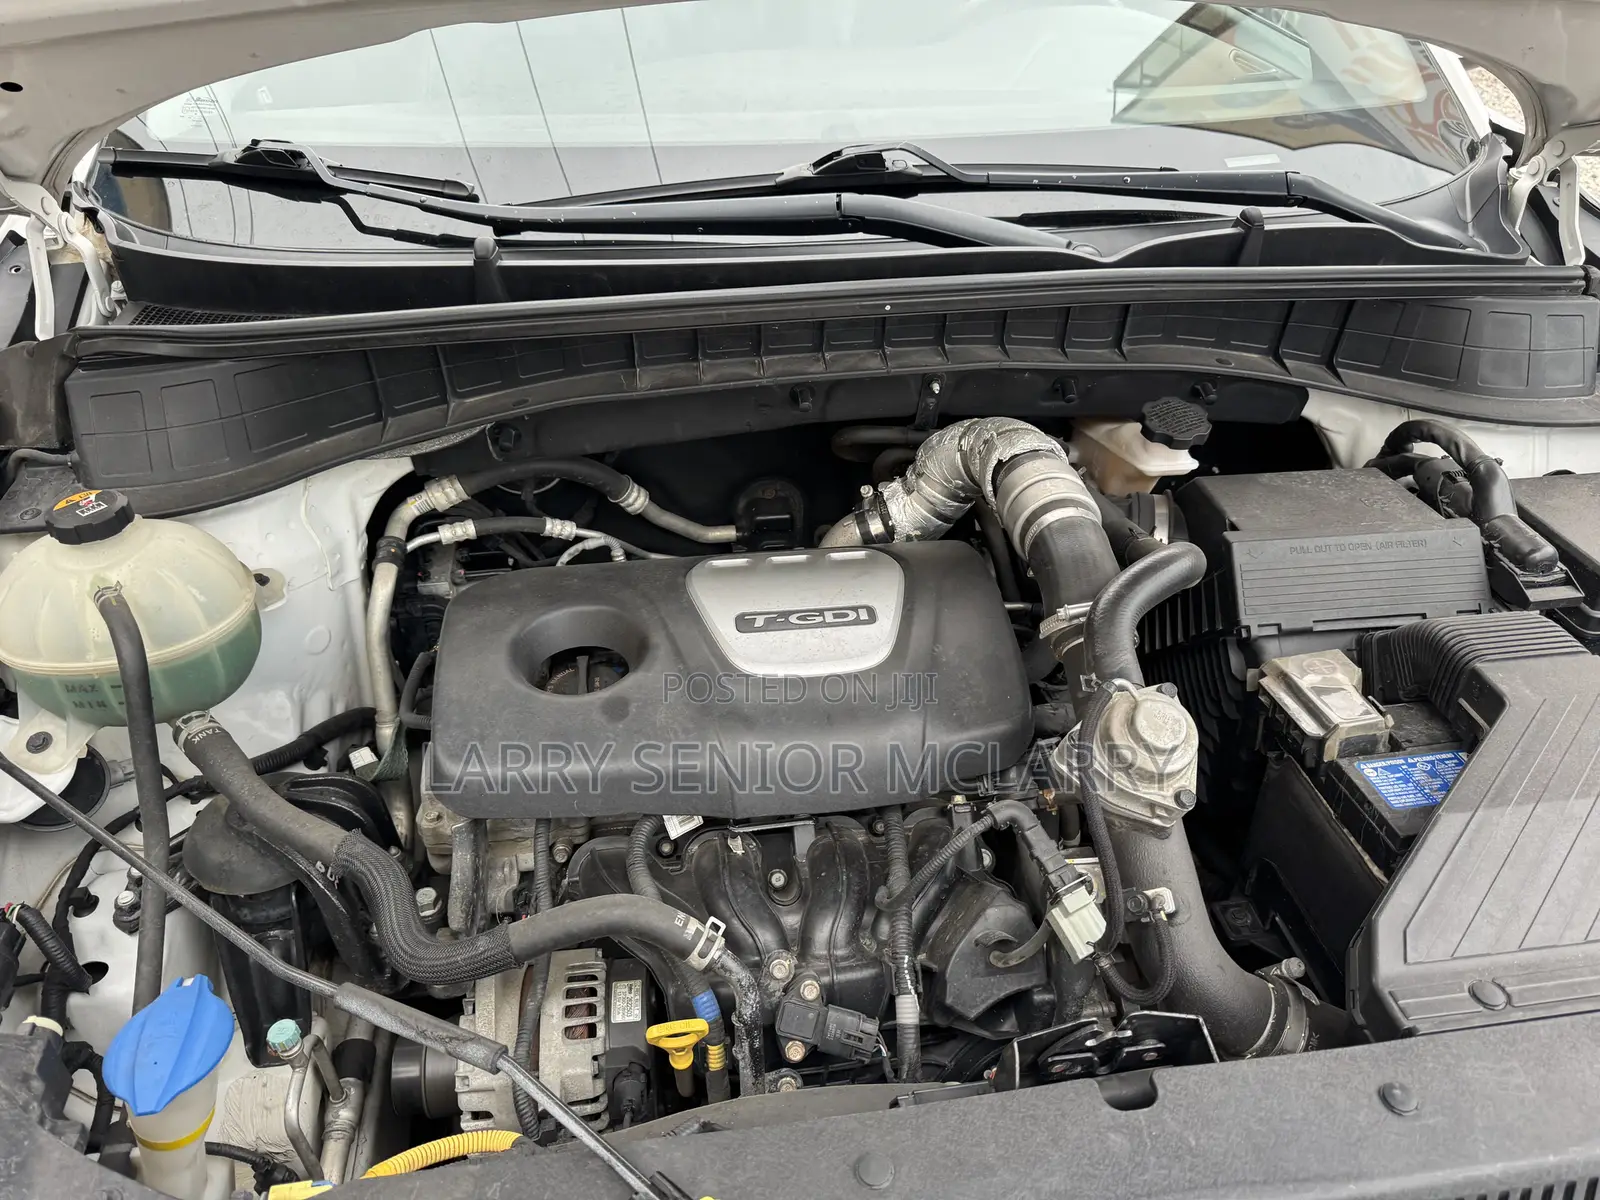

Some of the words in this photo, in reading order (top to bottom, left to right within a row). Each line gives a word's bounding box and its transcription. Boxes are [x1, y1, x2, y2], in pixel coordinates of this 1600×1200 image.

[1289, 545, 1312, 555] PULL
[1314, 545, 1332, 554] OUT
[1335, 544, 1346, 552] TO
[1348, 542, 1372, 551] OPEN
[1376, 540, 1394, 551] (AIR
[1396, 539, 1428, 550] FILTER)
[64, 684, 98, 694] MAX
[72, 700, 107, 709] MIN
[191, 728, 222, 745] TANK
